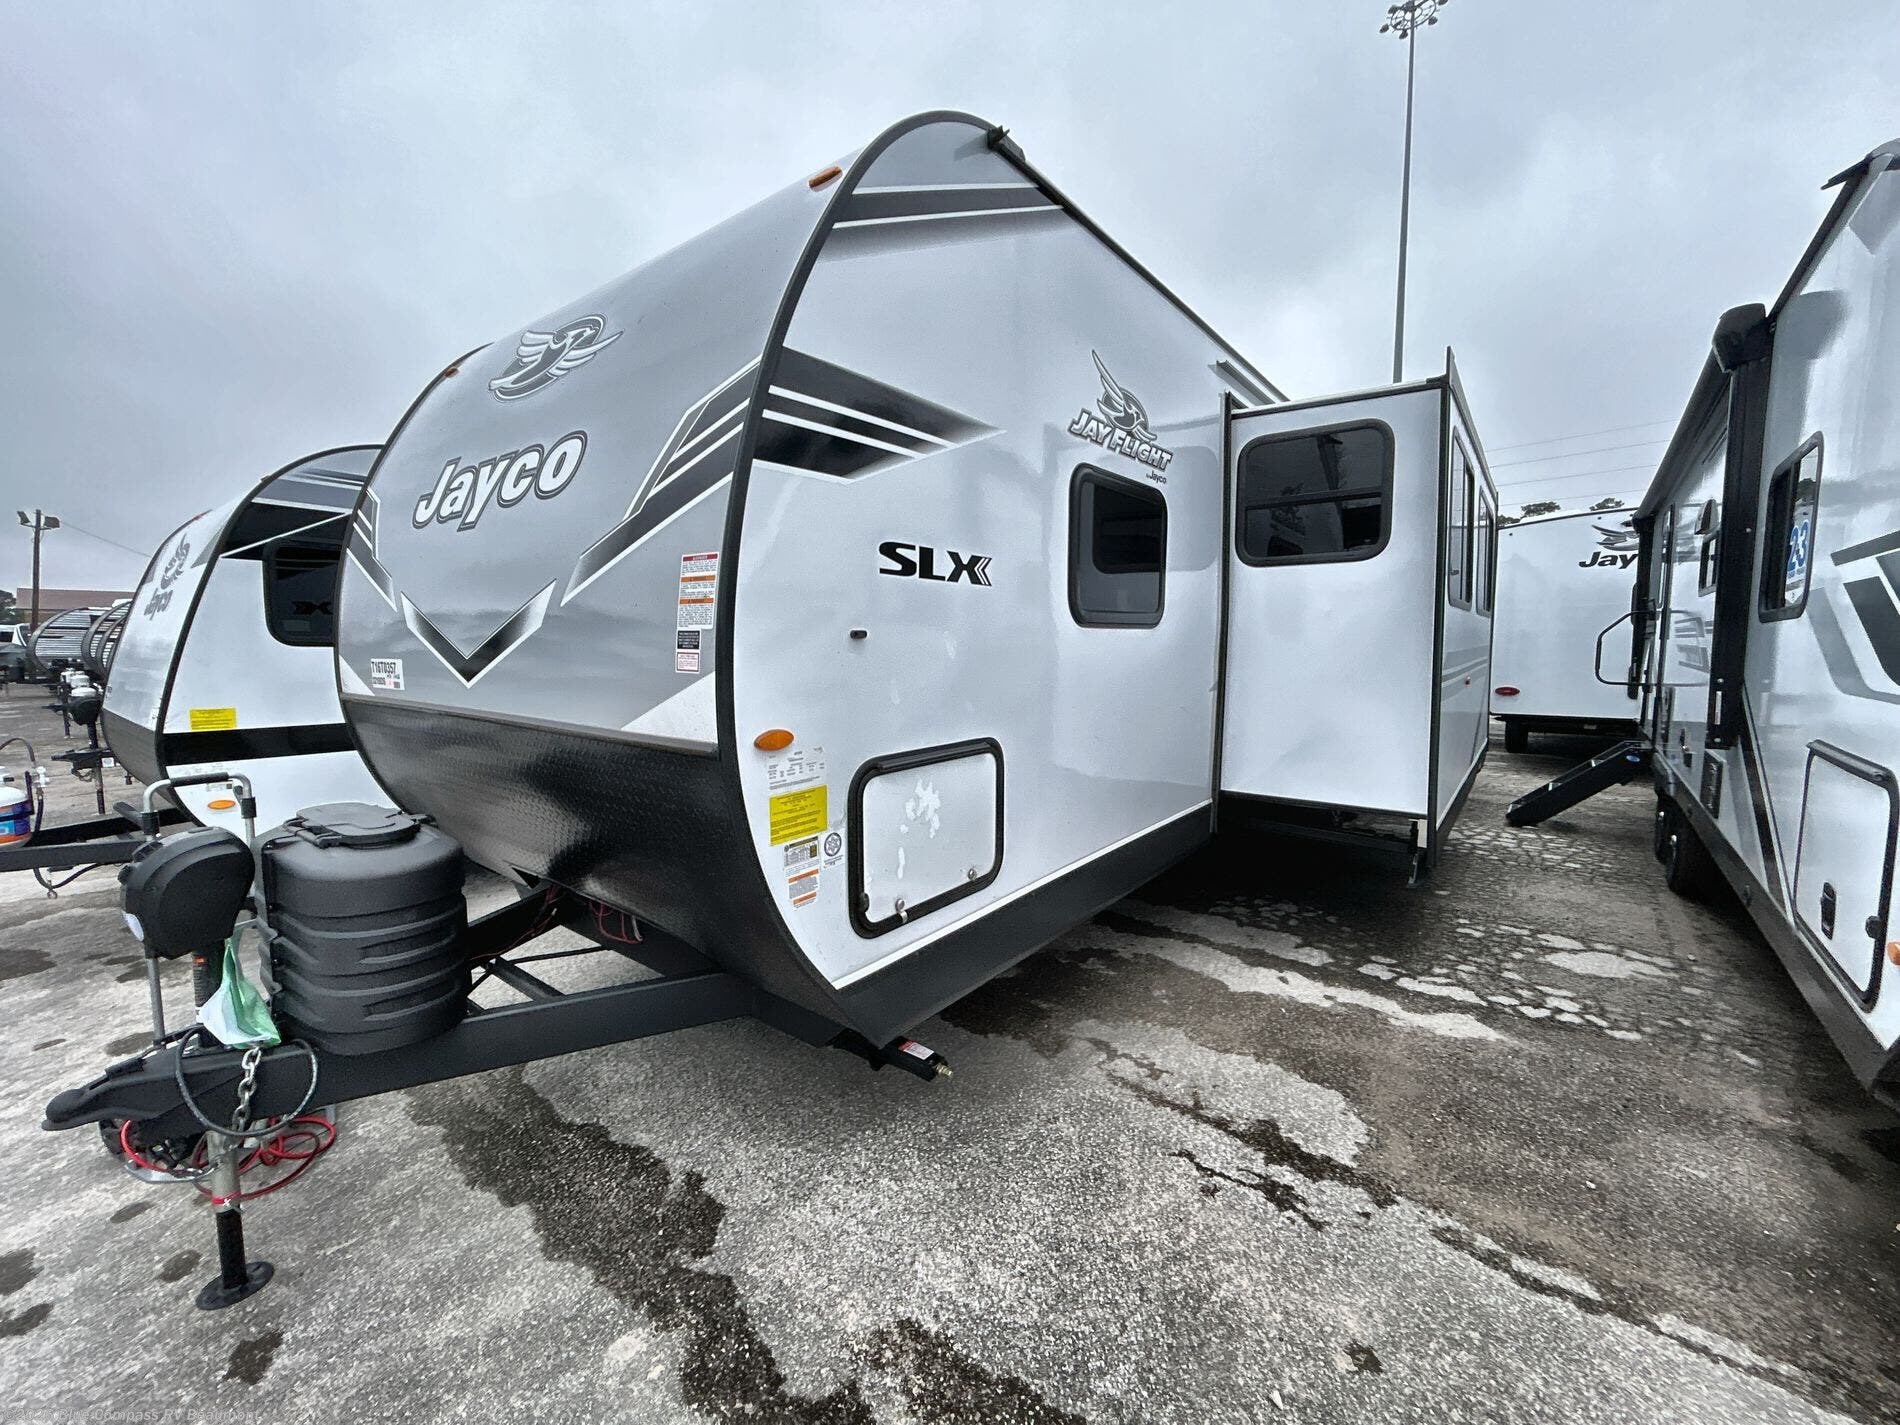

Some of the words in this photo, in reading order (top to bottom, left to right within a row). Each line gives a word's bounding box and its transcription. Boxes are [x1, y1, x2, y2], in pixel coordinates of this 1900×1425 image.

[1067, 409, 1111, 447] JAY
[1107, 428, 1173, 472] FLIGHT
[412, 430, 588, 532] Jayco
[878, 541, 992, 587] SLX
